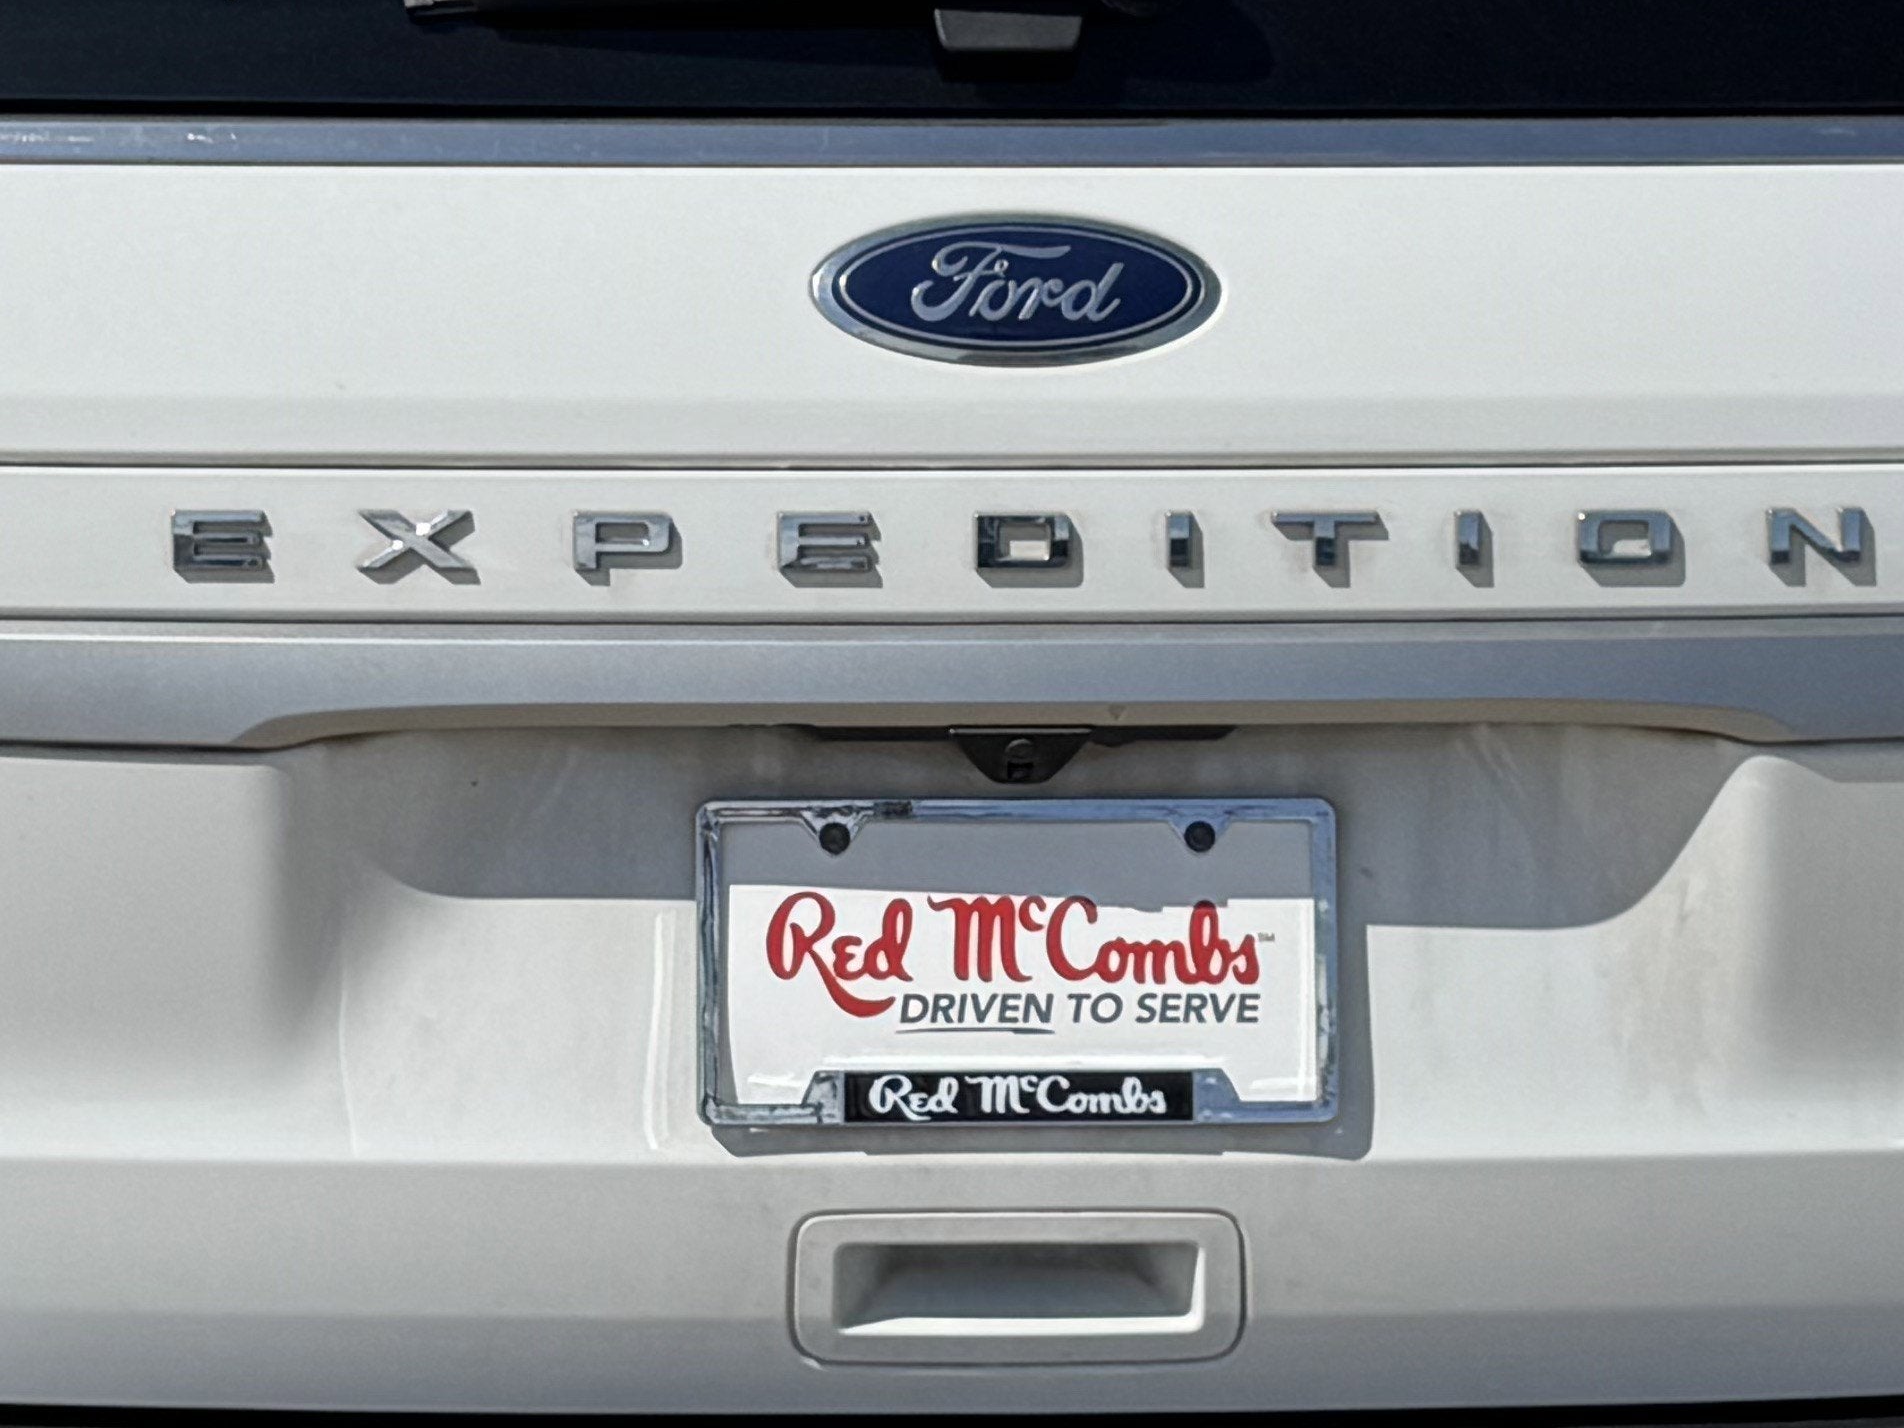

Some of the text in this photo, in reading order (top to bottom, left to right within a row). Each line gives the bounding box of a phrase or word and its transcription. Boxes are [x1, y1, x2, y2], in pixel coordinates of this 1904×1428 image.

[910, 240, 1125, 323] Ford
[170, 507, 1866, 576] EXPEDITION
[765, 891, 1261, 1018] Red McCombs
[898, 992, 1261, 1025] DRIVEN TO SERVE
[867, 1073, 1168, 1122] Red McCombs
